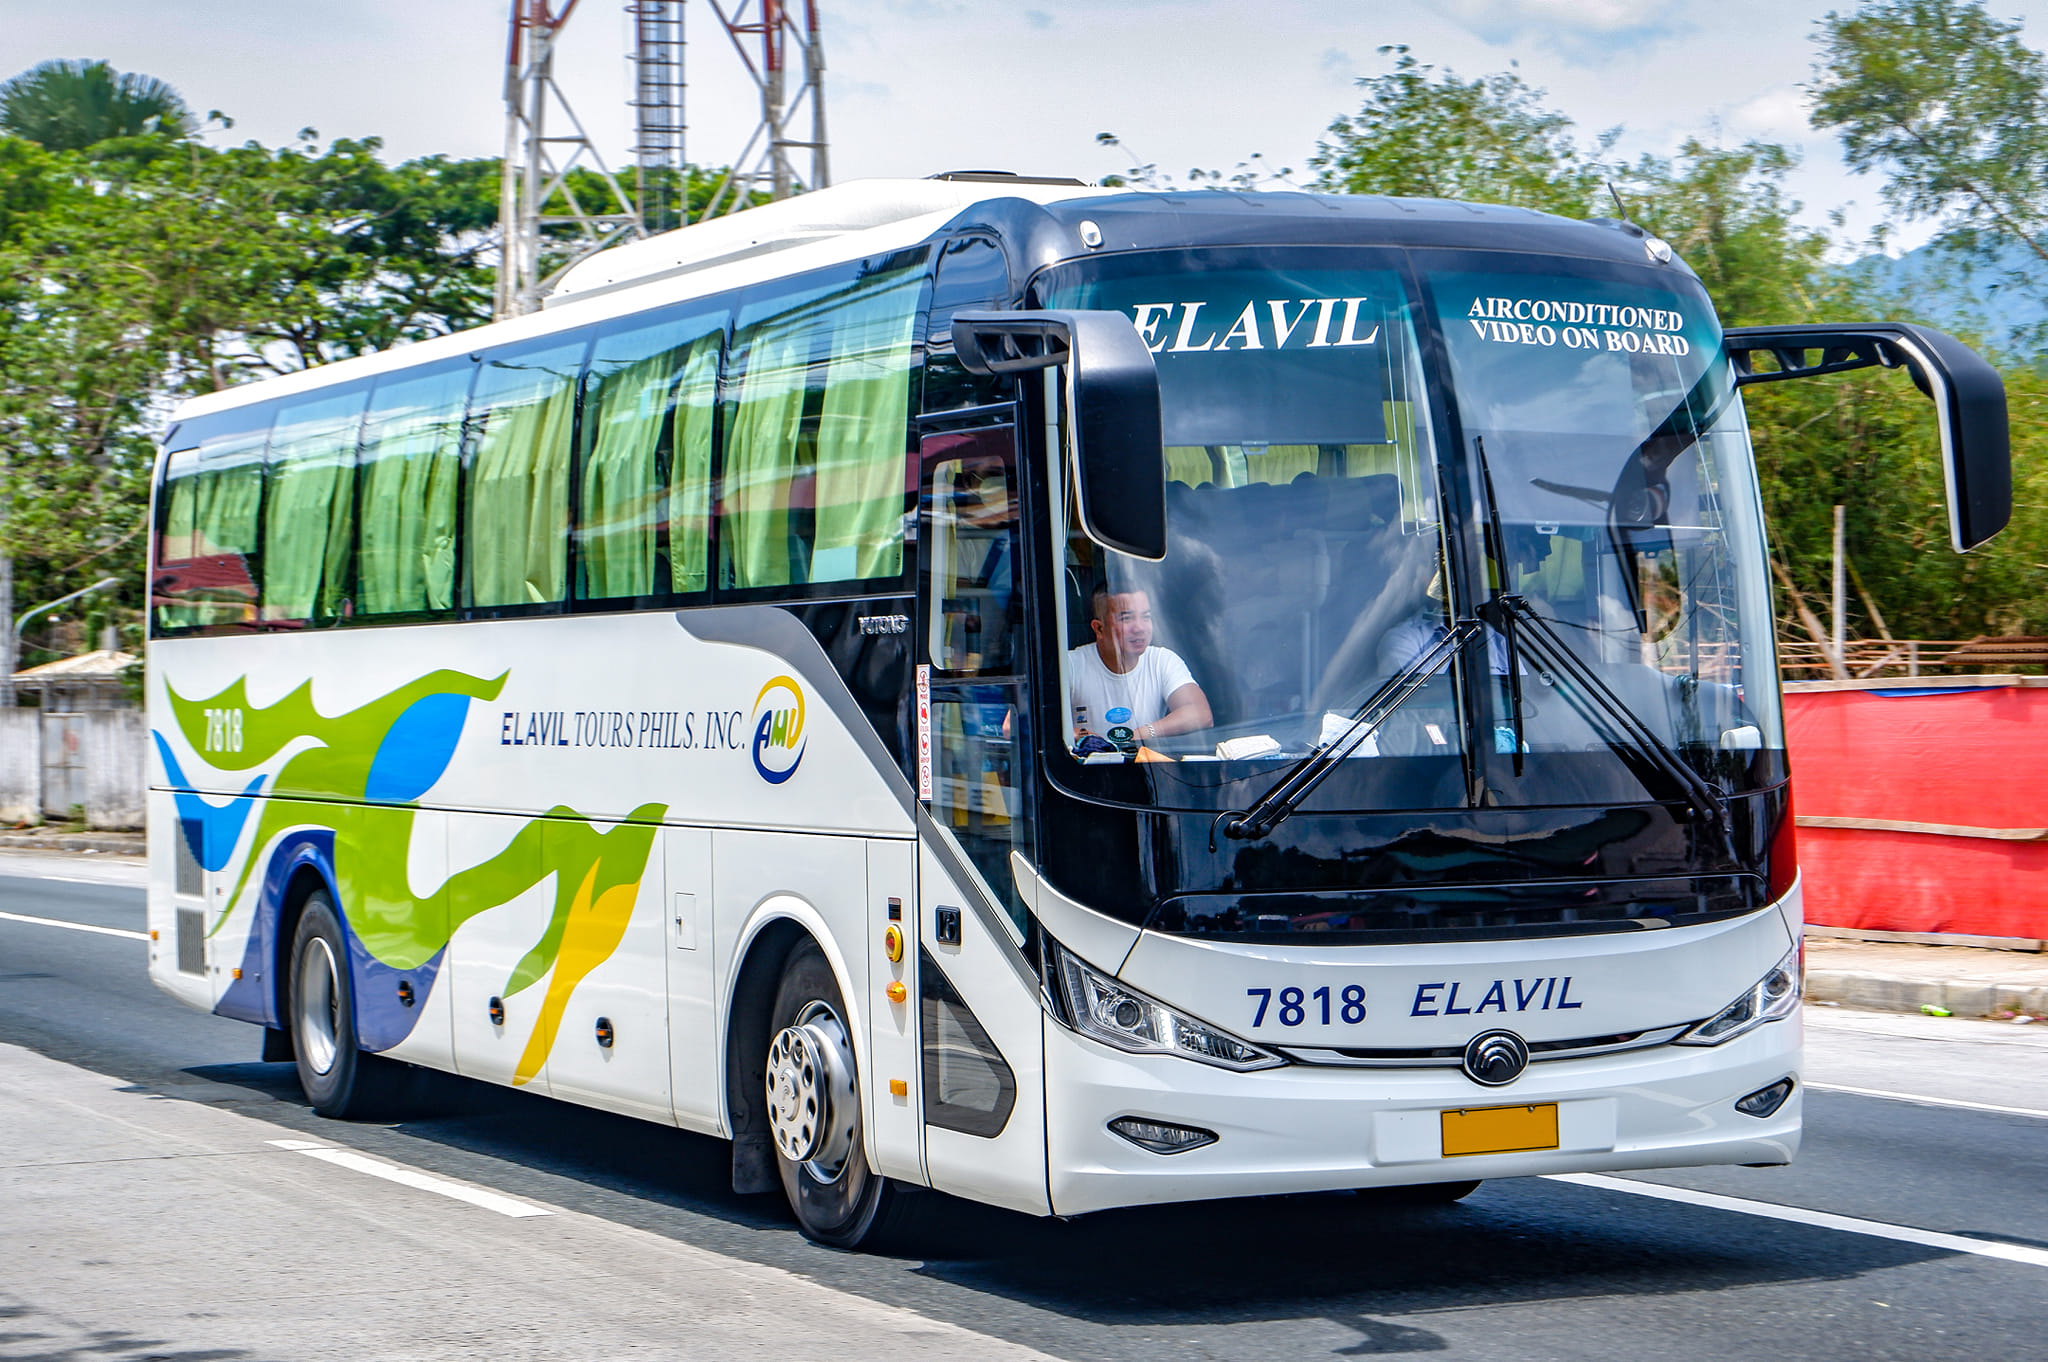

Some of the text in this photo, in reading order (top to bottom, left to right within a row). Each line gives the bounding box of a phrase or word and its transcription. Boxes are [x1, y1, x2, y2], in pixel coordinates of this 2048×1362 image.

[1132, 297, 1380, 353] ELAVIL
[1468, 297, 1682, 331] AIRCONDITIONED
[1470, 320, 1690, 356] VIDEO ON BOARD
[204, 709, 243, 752] 7818
[501, 712, 746, 749] ELAVIL TOURS PHILS. INC.
[1247, 977, 1583, 1028] 7818 ELAVIL
